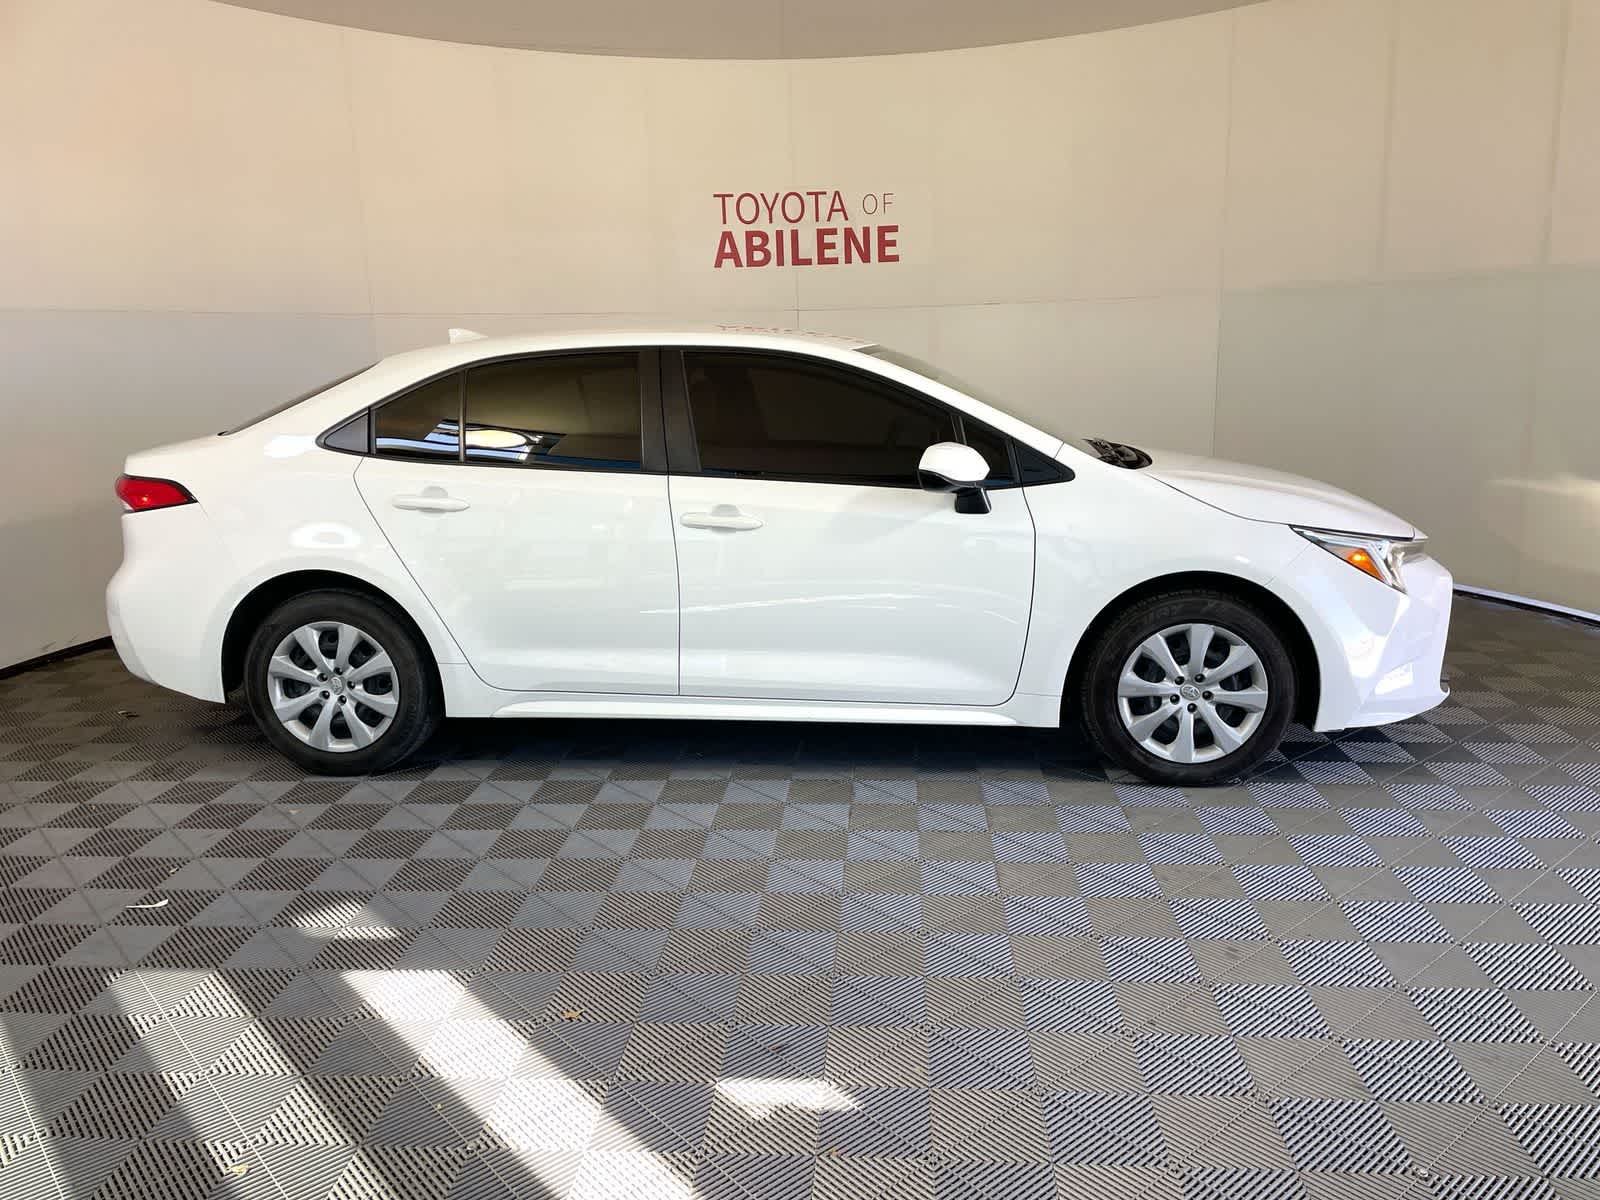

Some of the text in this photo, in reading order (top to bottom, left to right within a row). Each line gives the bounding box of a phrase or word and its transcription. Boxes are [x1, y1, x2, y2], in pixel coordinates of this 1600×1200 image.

[713, 190, 894, 225] TOYOTA OF
[713, 225, 900, 268] ABILENE
